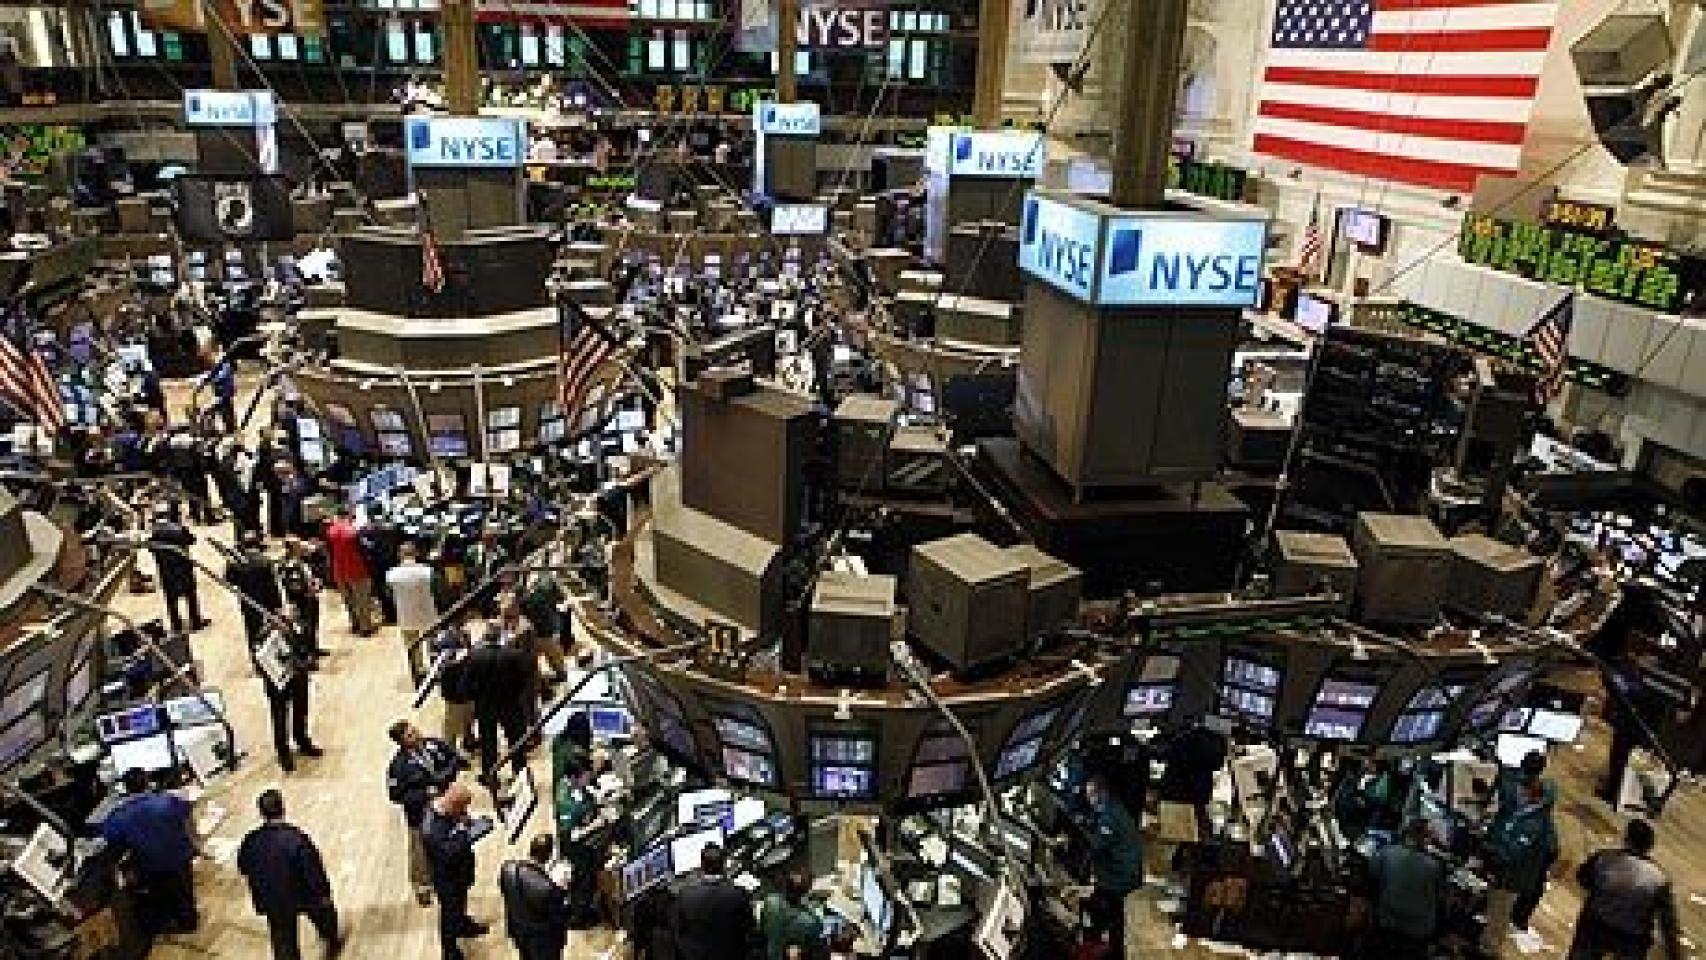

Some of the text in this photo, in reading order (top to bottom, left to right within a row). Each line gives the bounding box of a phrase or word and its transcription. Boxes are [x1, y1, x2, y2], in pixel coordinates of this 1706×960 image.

[440, 136, 513, 161] NYSE
[978, 151, 1037, 171] NYSE
[1037, 229, 1091, 291] NYSE
[1148, 252, 1258, 291] NYSE
